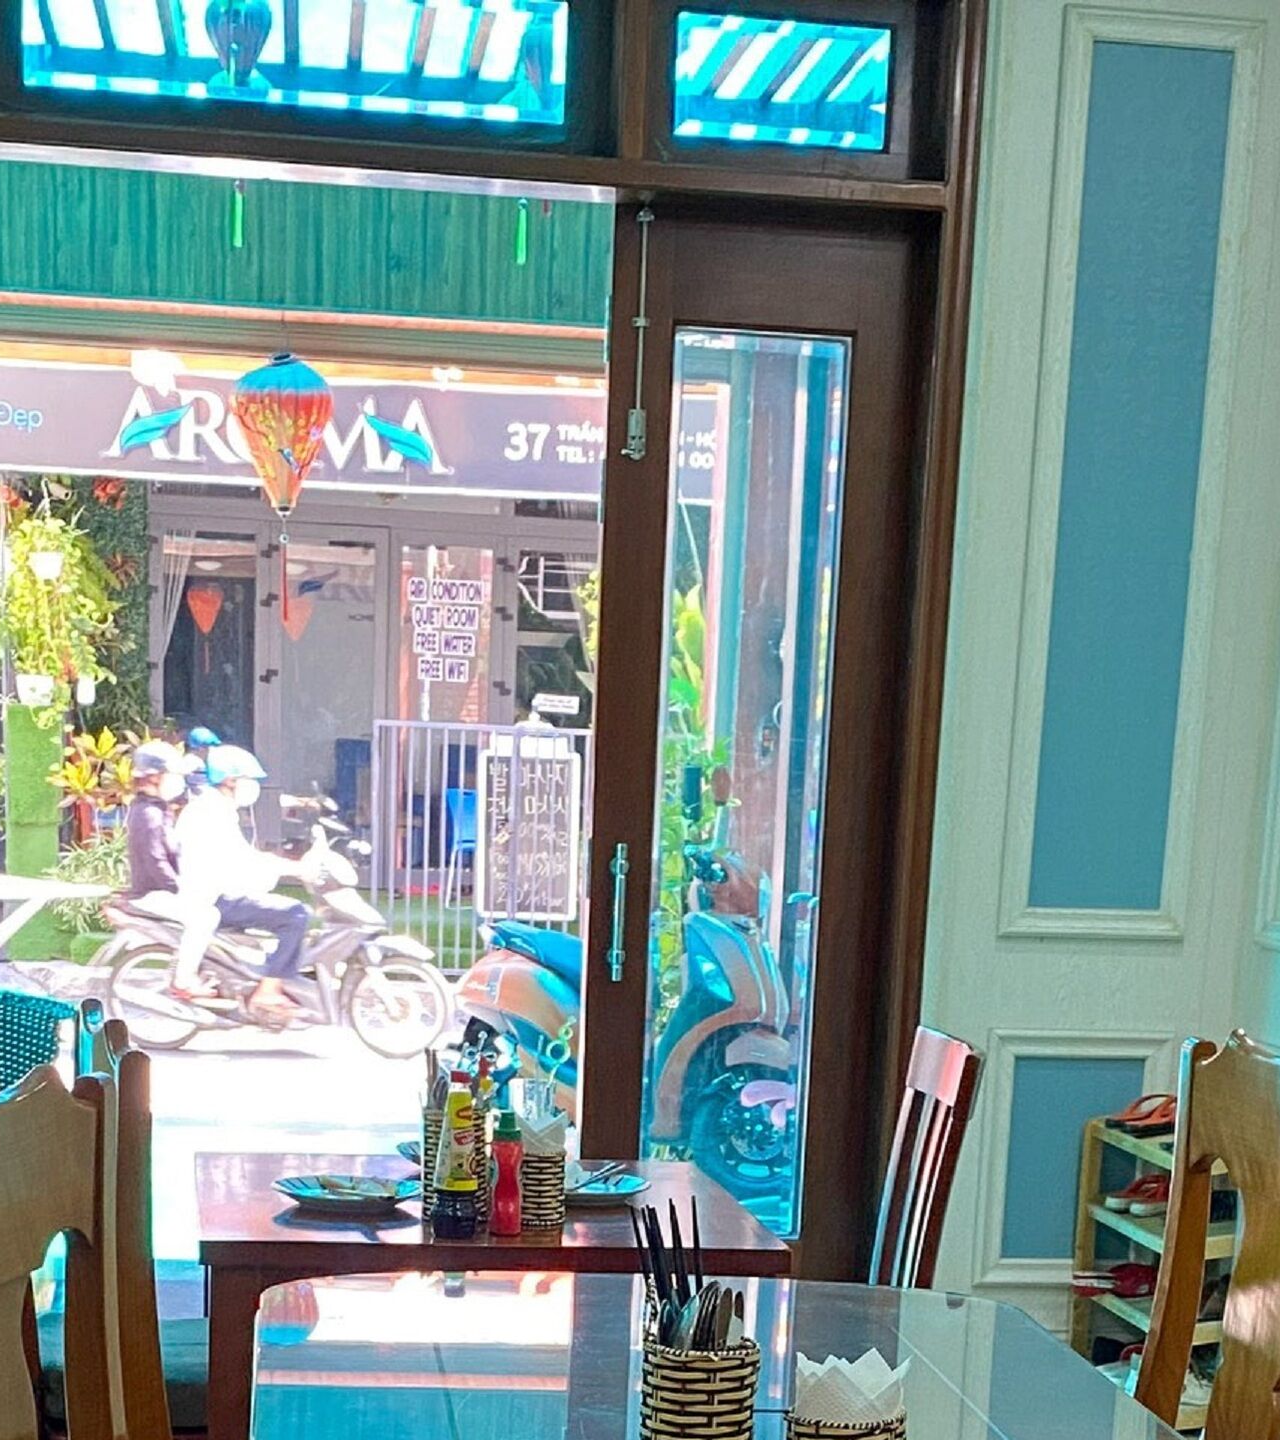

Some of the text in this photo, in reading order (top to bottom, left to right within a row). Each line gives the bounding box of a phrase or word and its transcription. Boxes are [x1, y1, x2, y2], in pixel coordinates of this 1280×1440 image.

[100, 385, 454, 476] ARMA
[504, 421, 551, 461] 37
[431, 581, 483, 602] CONDITION
[415, 606, 477, 627] QUIET ROOM
[416, 632, 473, 654] FREE WATER
[420, 660, 441, 679] FREE
